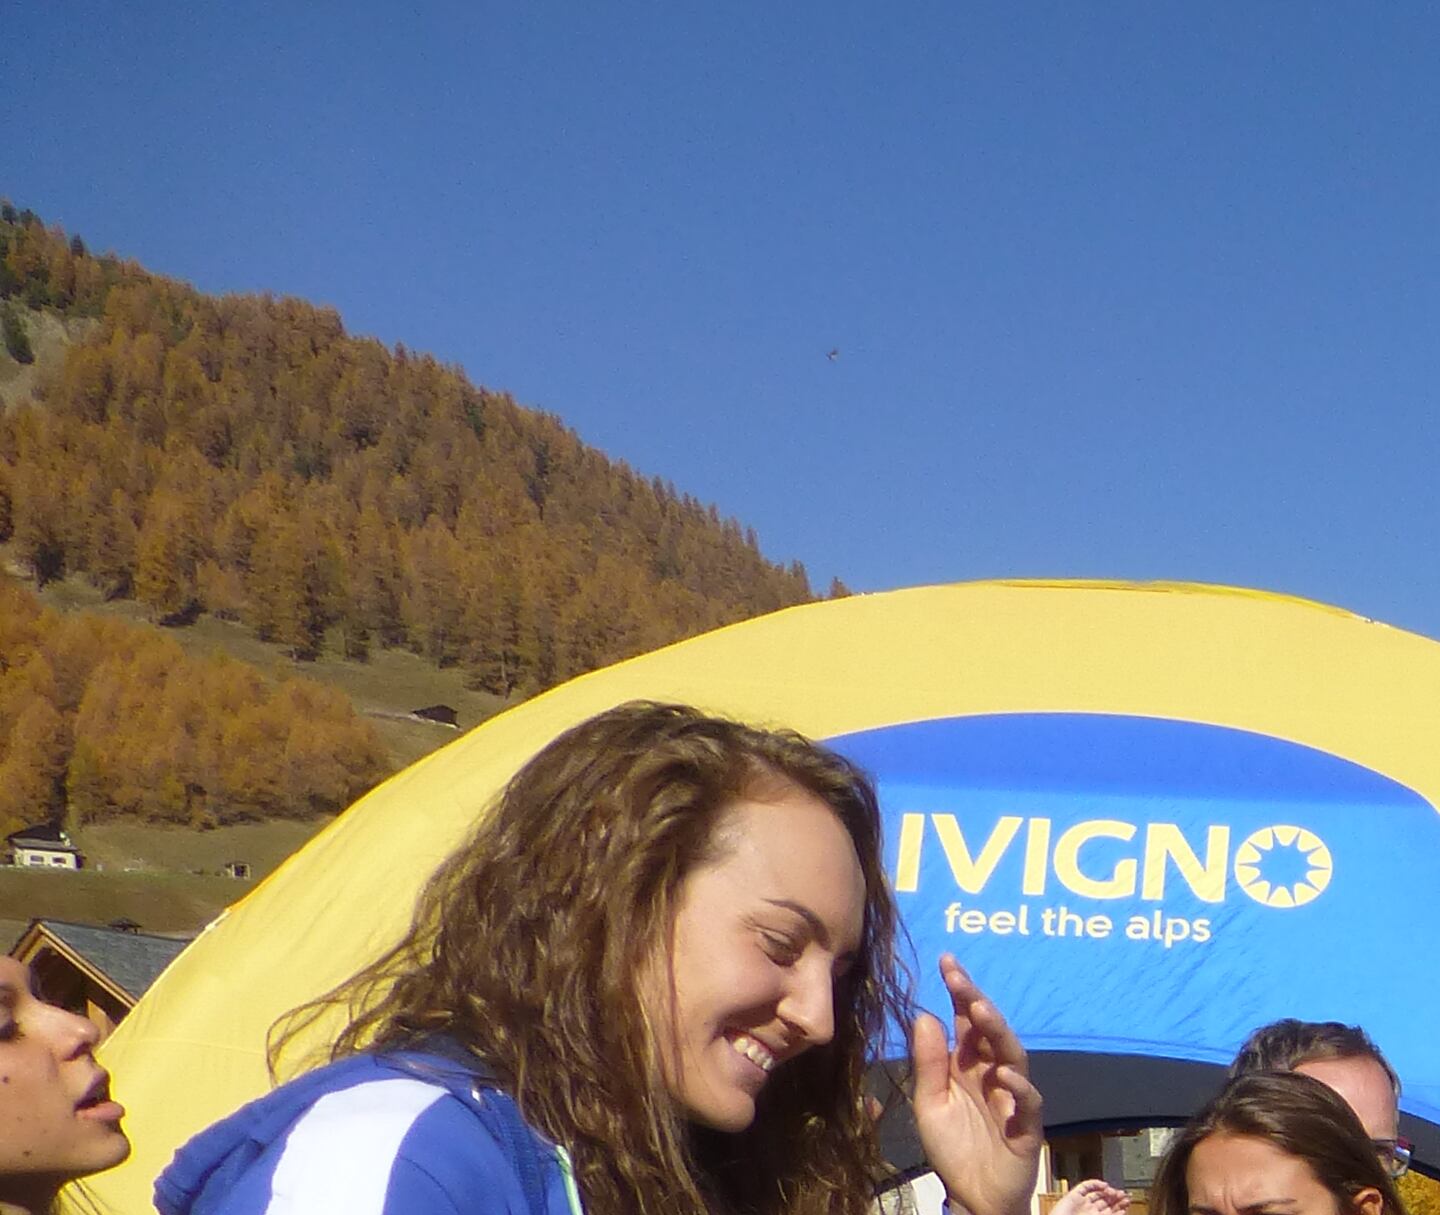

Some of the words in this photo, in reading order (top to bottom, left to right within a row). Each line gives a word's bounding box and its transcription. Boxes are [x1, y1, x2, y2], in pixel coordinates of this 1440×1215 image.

[896, 812, 1333, 908] IVIGNO
[944, 902, 1030, 936] feel
[1041, 906, 1113, 938] the
[1126, 910, 1212, 948] alps
